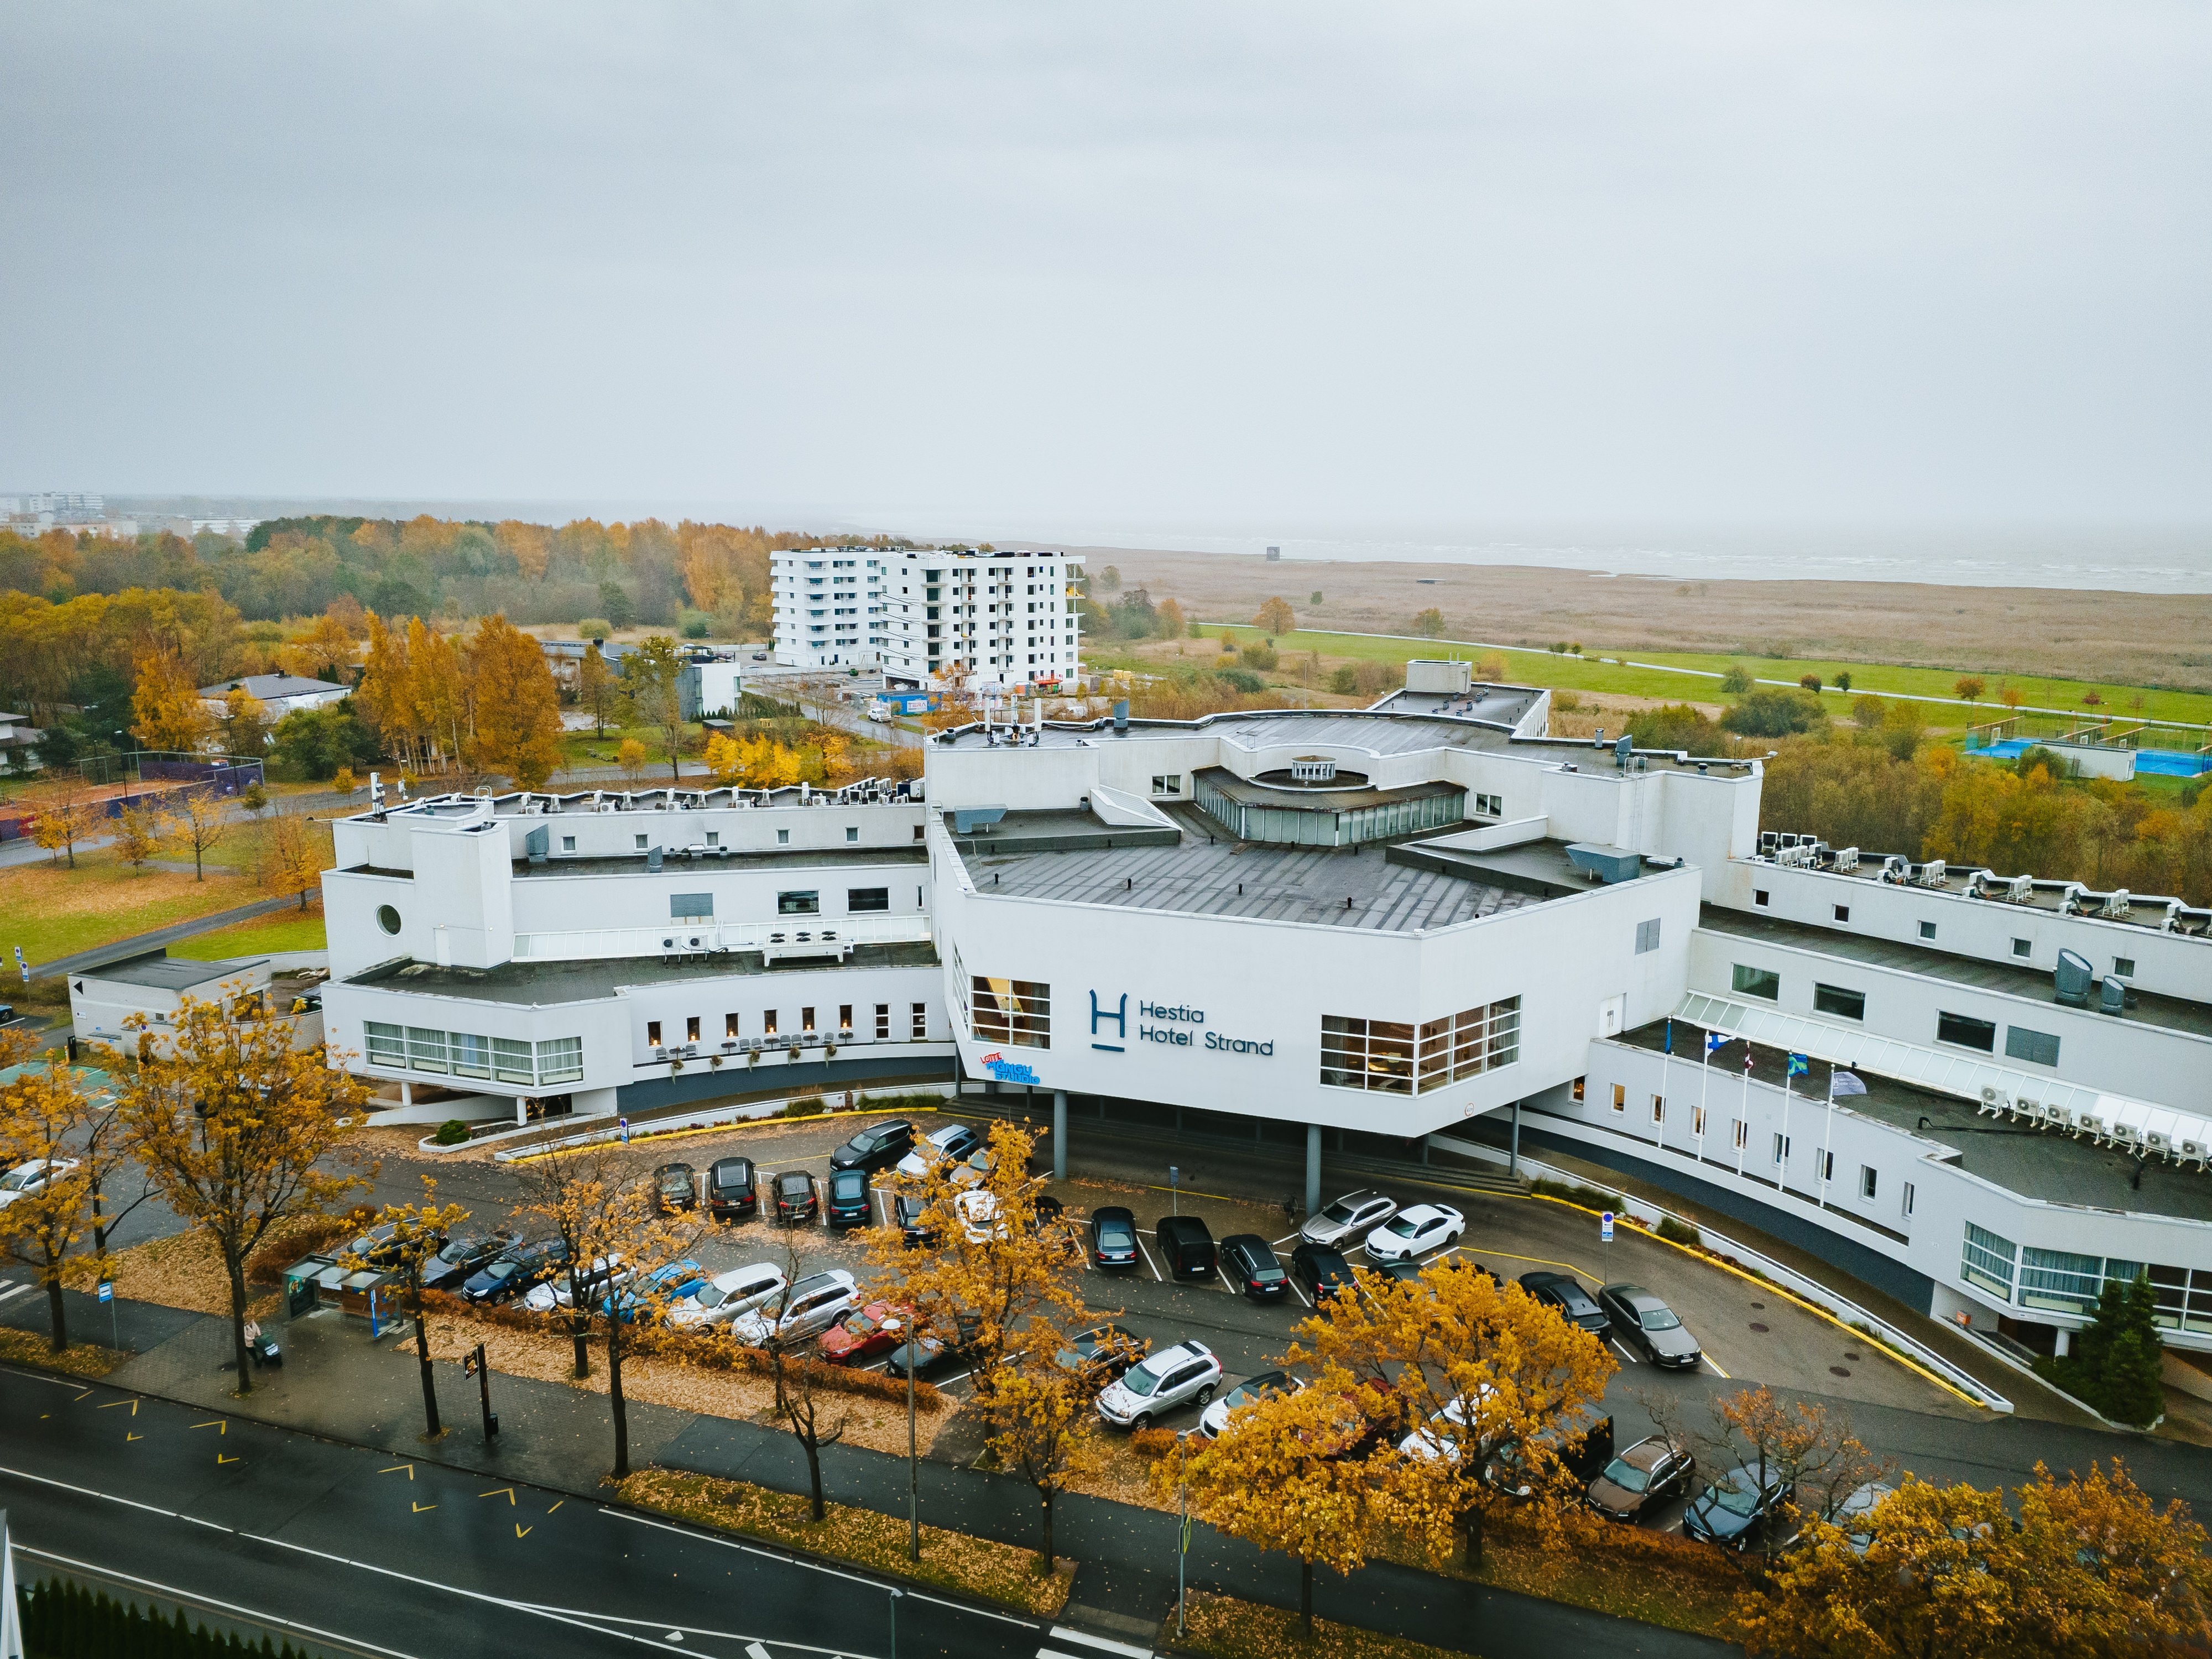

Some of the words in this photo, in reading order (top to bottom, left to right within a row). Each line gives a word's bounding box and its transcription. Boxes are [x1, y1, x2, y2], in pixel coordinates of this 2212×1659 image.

[1089, 989, 1128, 1038] H
[1140, 1000, 1204, 1023] Hestia
[1140, 1024, 1193, 1046] Hotel
[1205, 1031, 1274, 1056] Strand
[980, 1052, 1003, 1064] LOTTE
[995, 1071, 1040, 1084] STUUDIO
